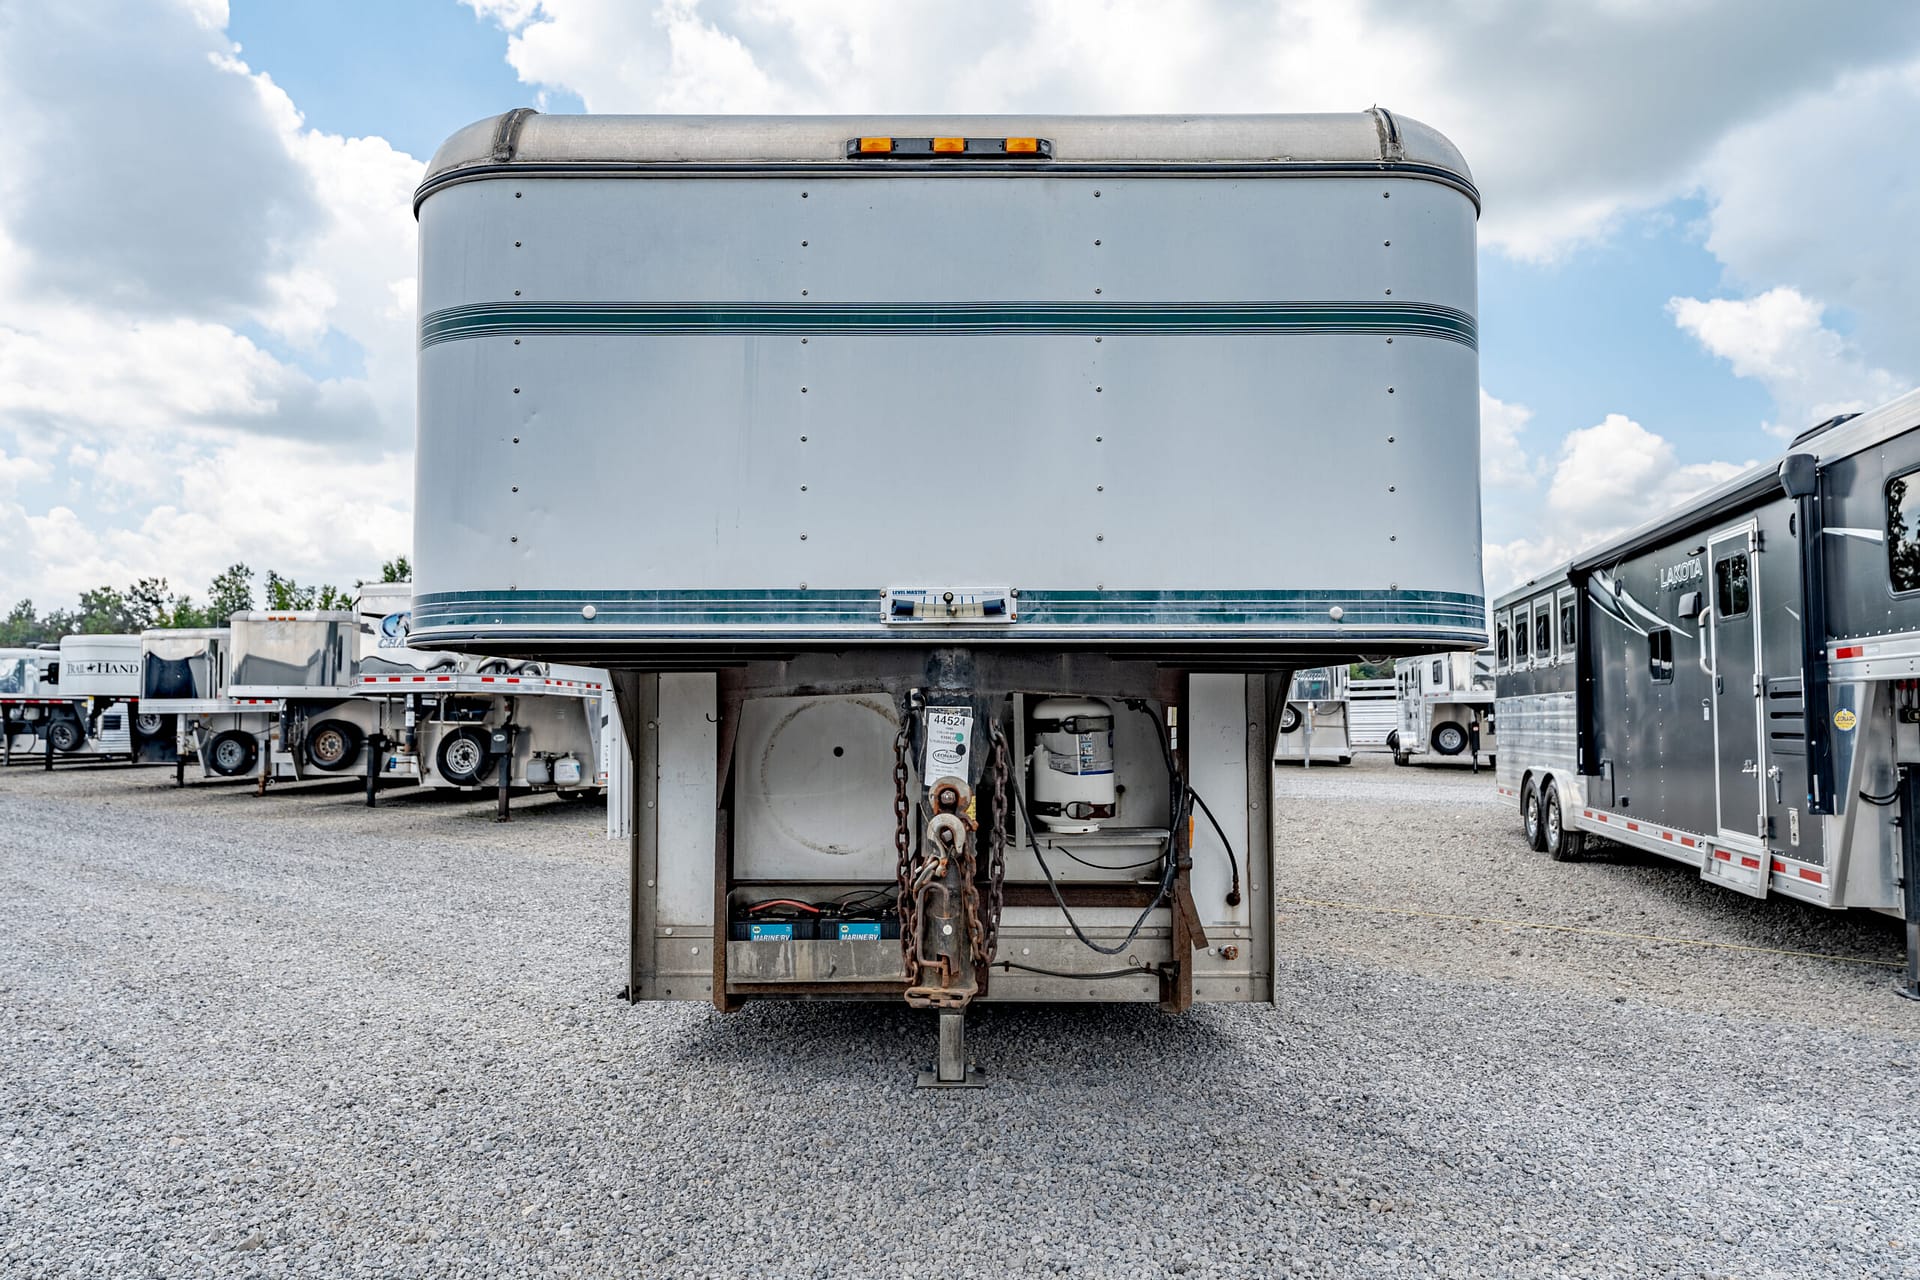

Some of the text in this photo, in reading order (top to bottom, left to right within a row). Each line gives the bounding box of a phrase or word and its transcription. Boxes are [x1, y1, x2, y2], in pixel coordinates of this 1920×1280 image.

[1660, 558, 1703, 588] LAKOTA
[67, 662, 139, 674] TRAIL HAND
[934, 714, 966, 728] 44524
